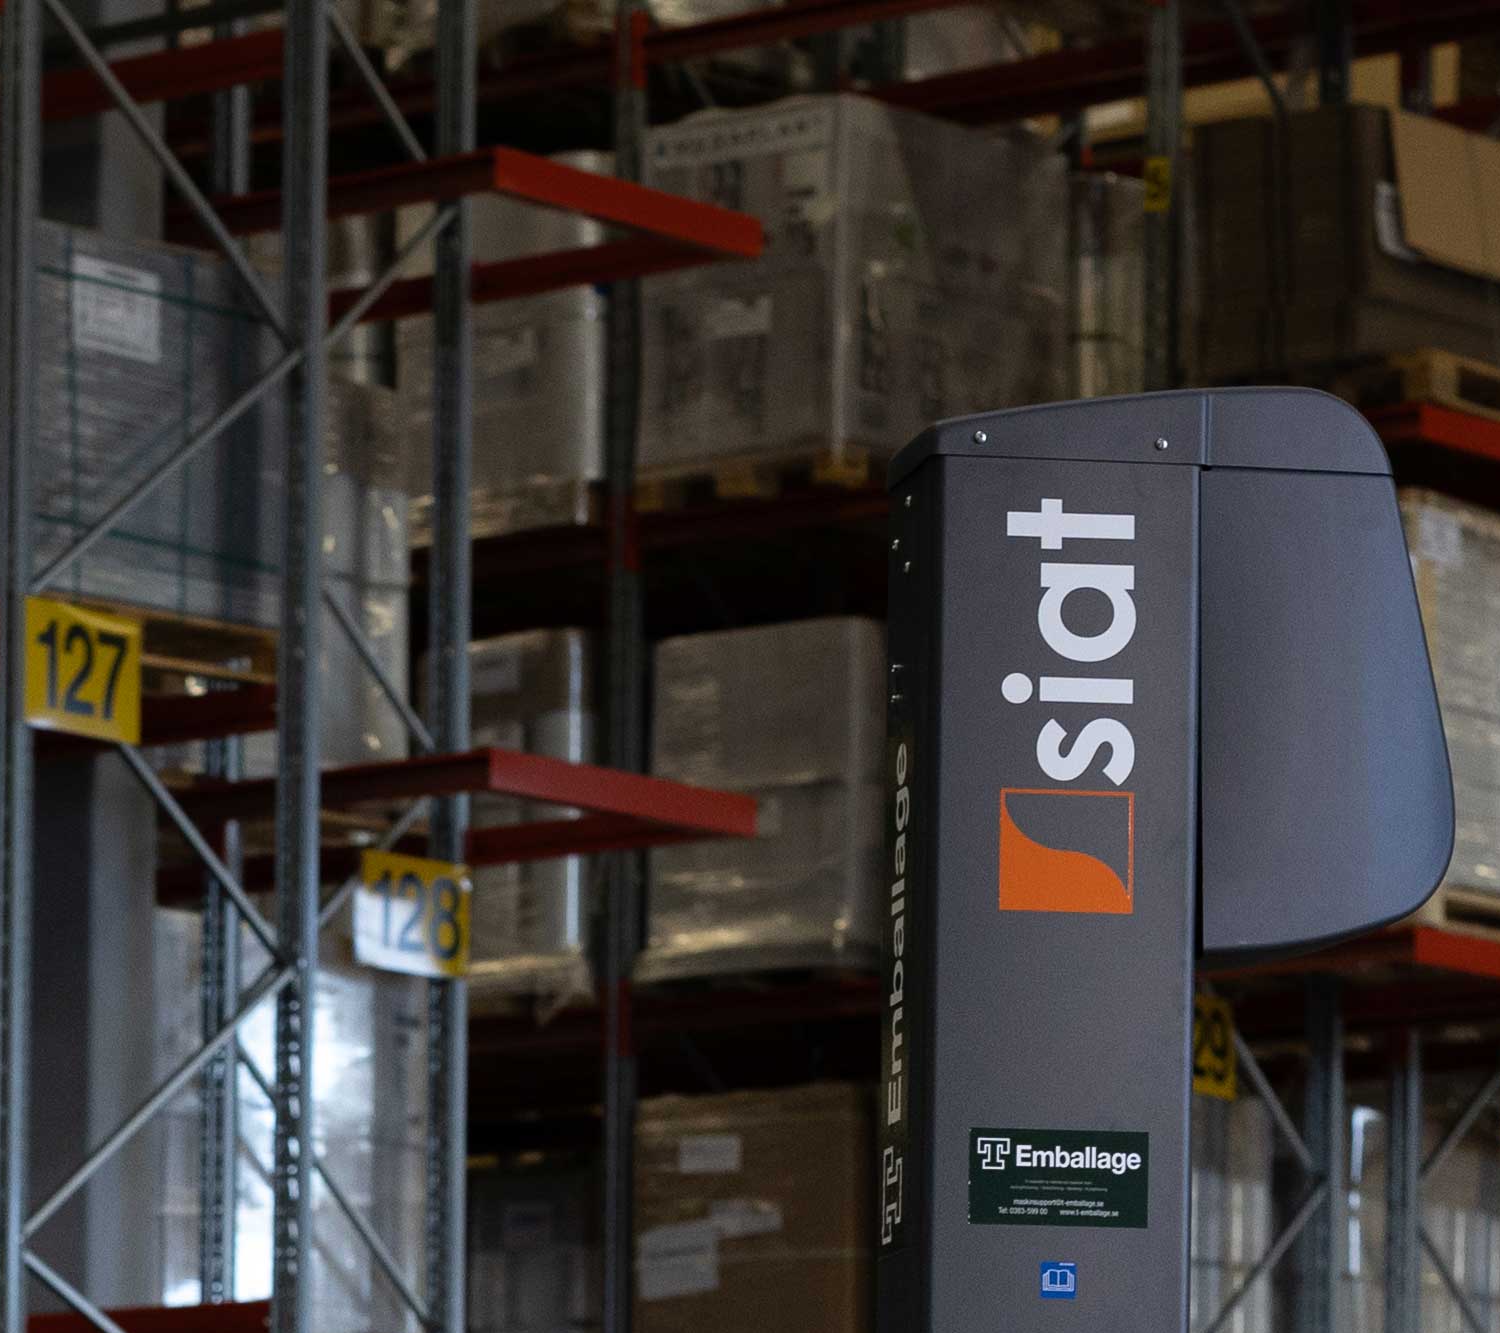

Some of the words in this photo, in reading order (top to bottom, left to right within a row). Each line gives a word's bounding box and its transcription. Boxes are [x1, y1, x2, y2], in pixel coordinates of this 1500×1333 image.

[36, 619, 127, 719] 127
[1001, 498, 1136, 786] siat
[374, 869, 459, 959] 128
[887, 742, 911, 1127] Emballage
[1015, 1144, 1142, 1175] Emballage
